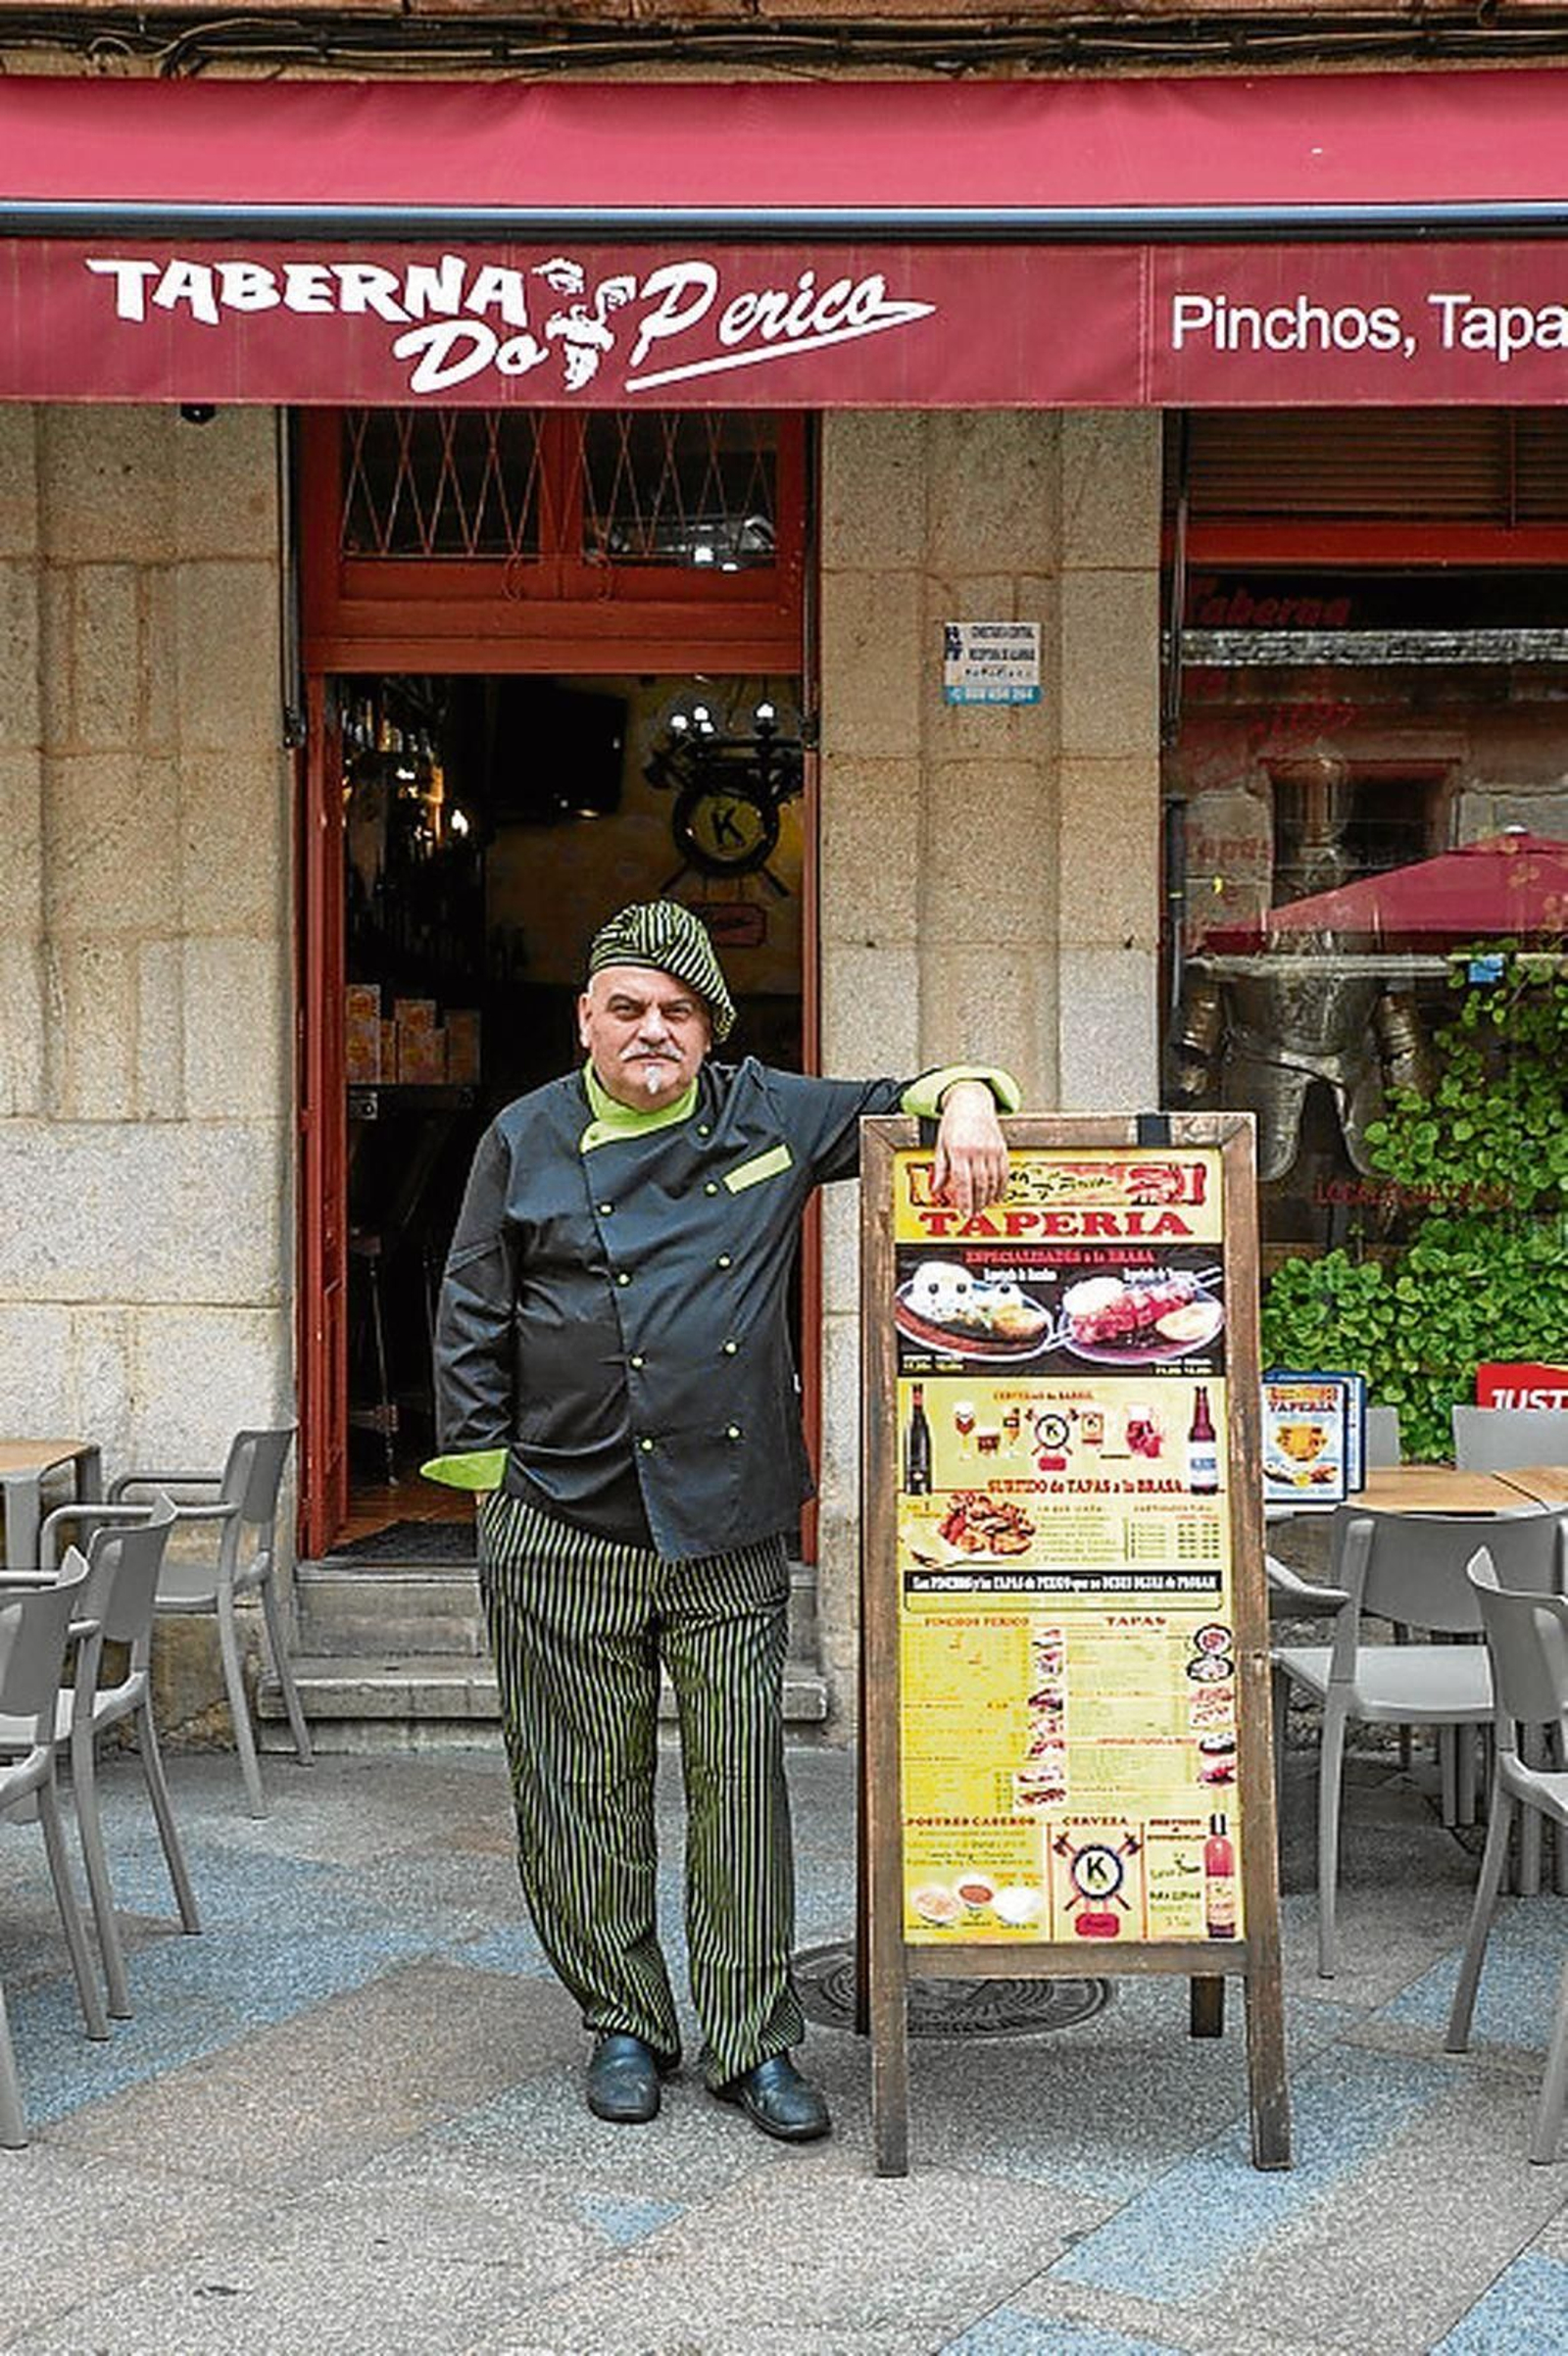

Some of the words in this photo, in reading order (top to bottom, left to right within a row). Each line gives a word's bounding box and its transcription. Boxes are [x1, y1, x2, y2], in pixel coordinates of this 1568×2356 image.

[84, 254, 527, 328] TABERNA
[392, 319, 549, 394] Do
[628, 261, 936, 368] Perico
[1172, 294, 1416, 359] Pinchos,
[1427, 293, 1568, 363] Tapa
[918, 1211, 1195, 1237] TAPERIA
[1492, 1388, 1568, 1409] JUST
